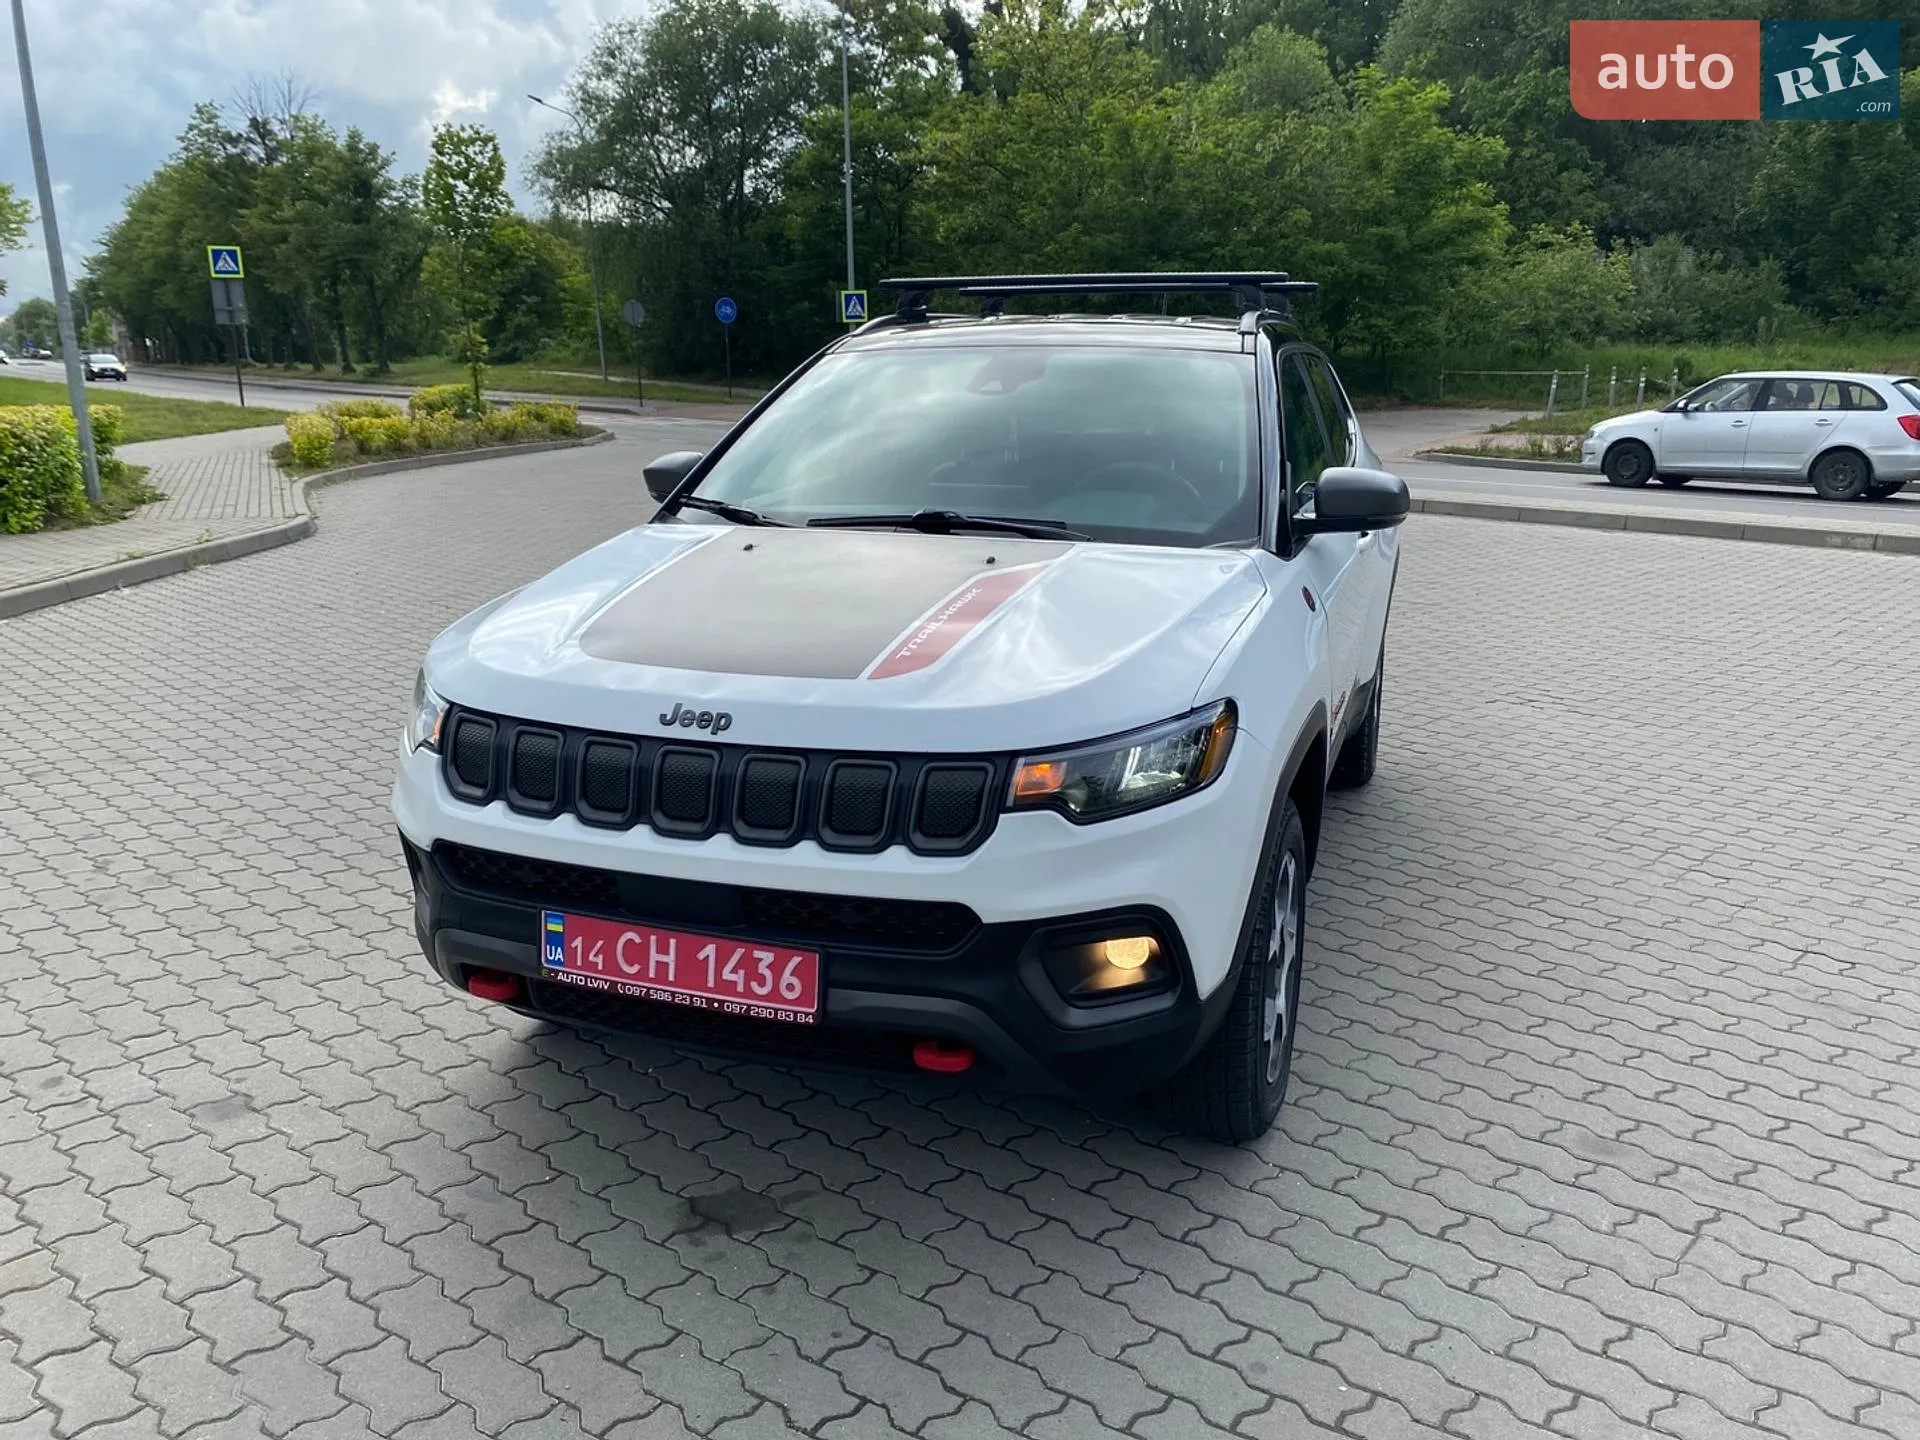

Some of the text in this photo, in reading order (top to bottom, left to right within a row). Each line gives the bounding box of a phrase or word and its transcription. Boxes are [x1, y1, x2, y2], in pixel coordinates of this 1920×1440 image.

[895, 587, 982, 660] TRAILHAWK
[659, 702, 733, 735] Jeep
[546, 944, 564, 962] UA
[570, 931, 803, 1000] 14 CH 1436
[557, 972, 585, 986] AUTO
[587, 977, 610, 990] LVIV
[675, 994, 690, 1005] 23
[693, 997, 708, 1008] 91
[750, 1007, 774, 1018] 290
